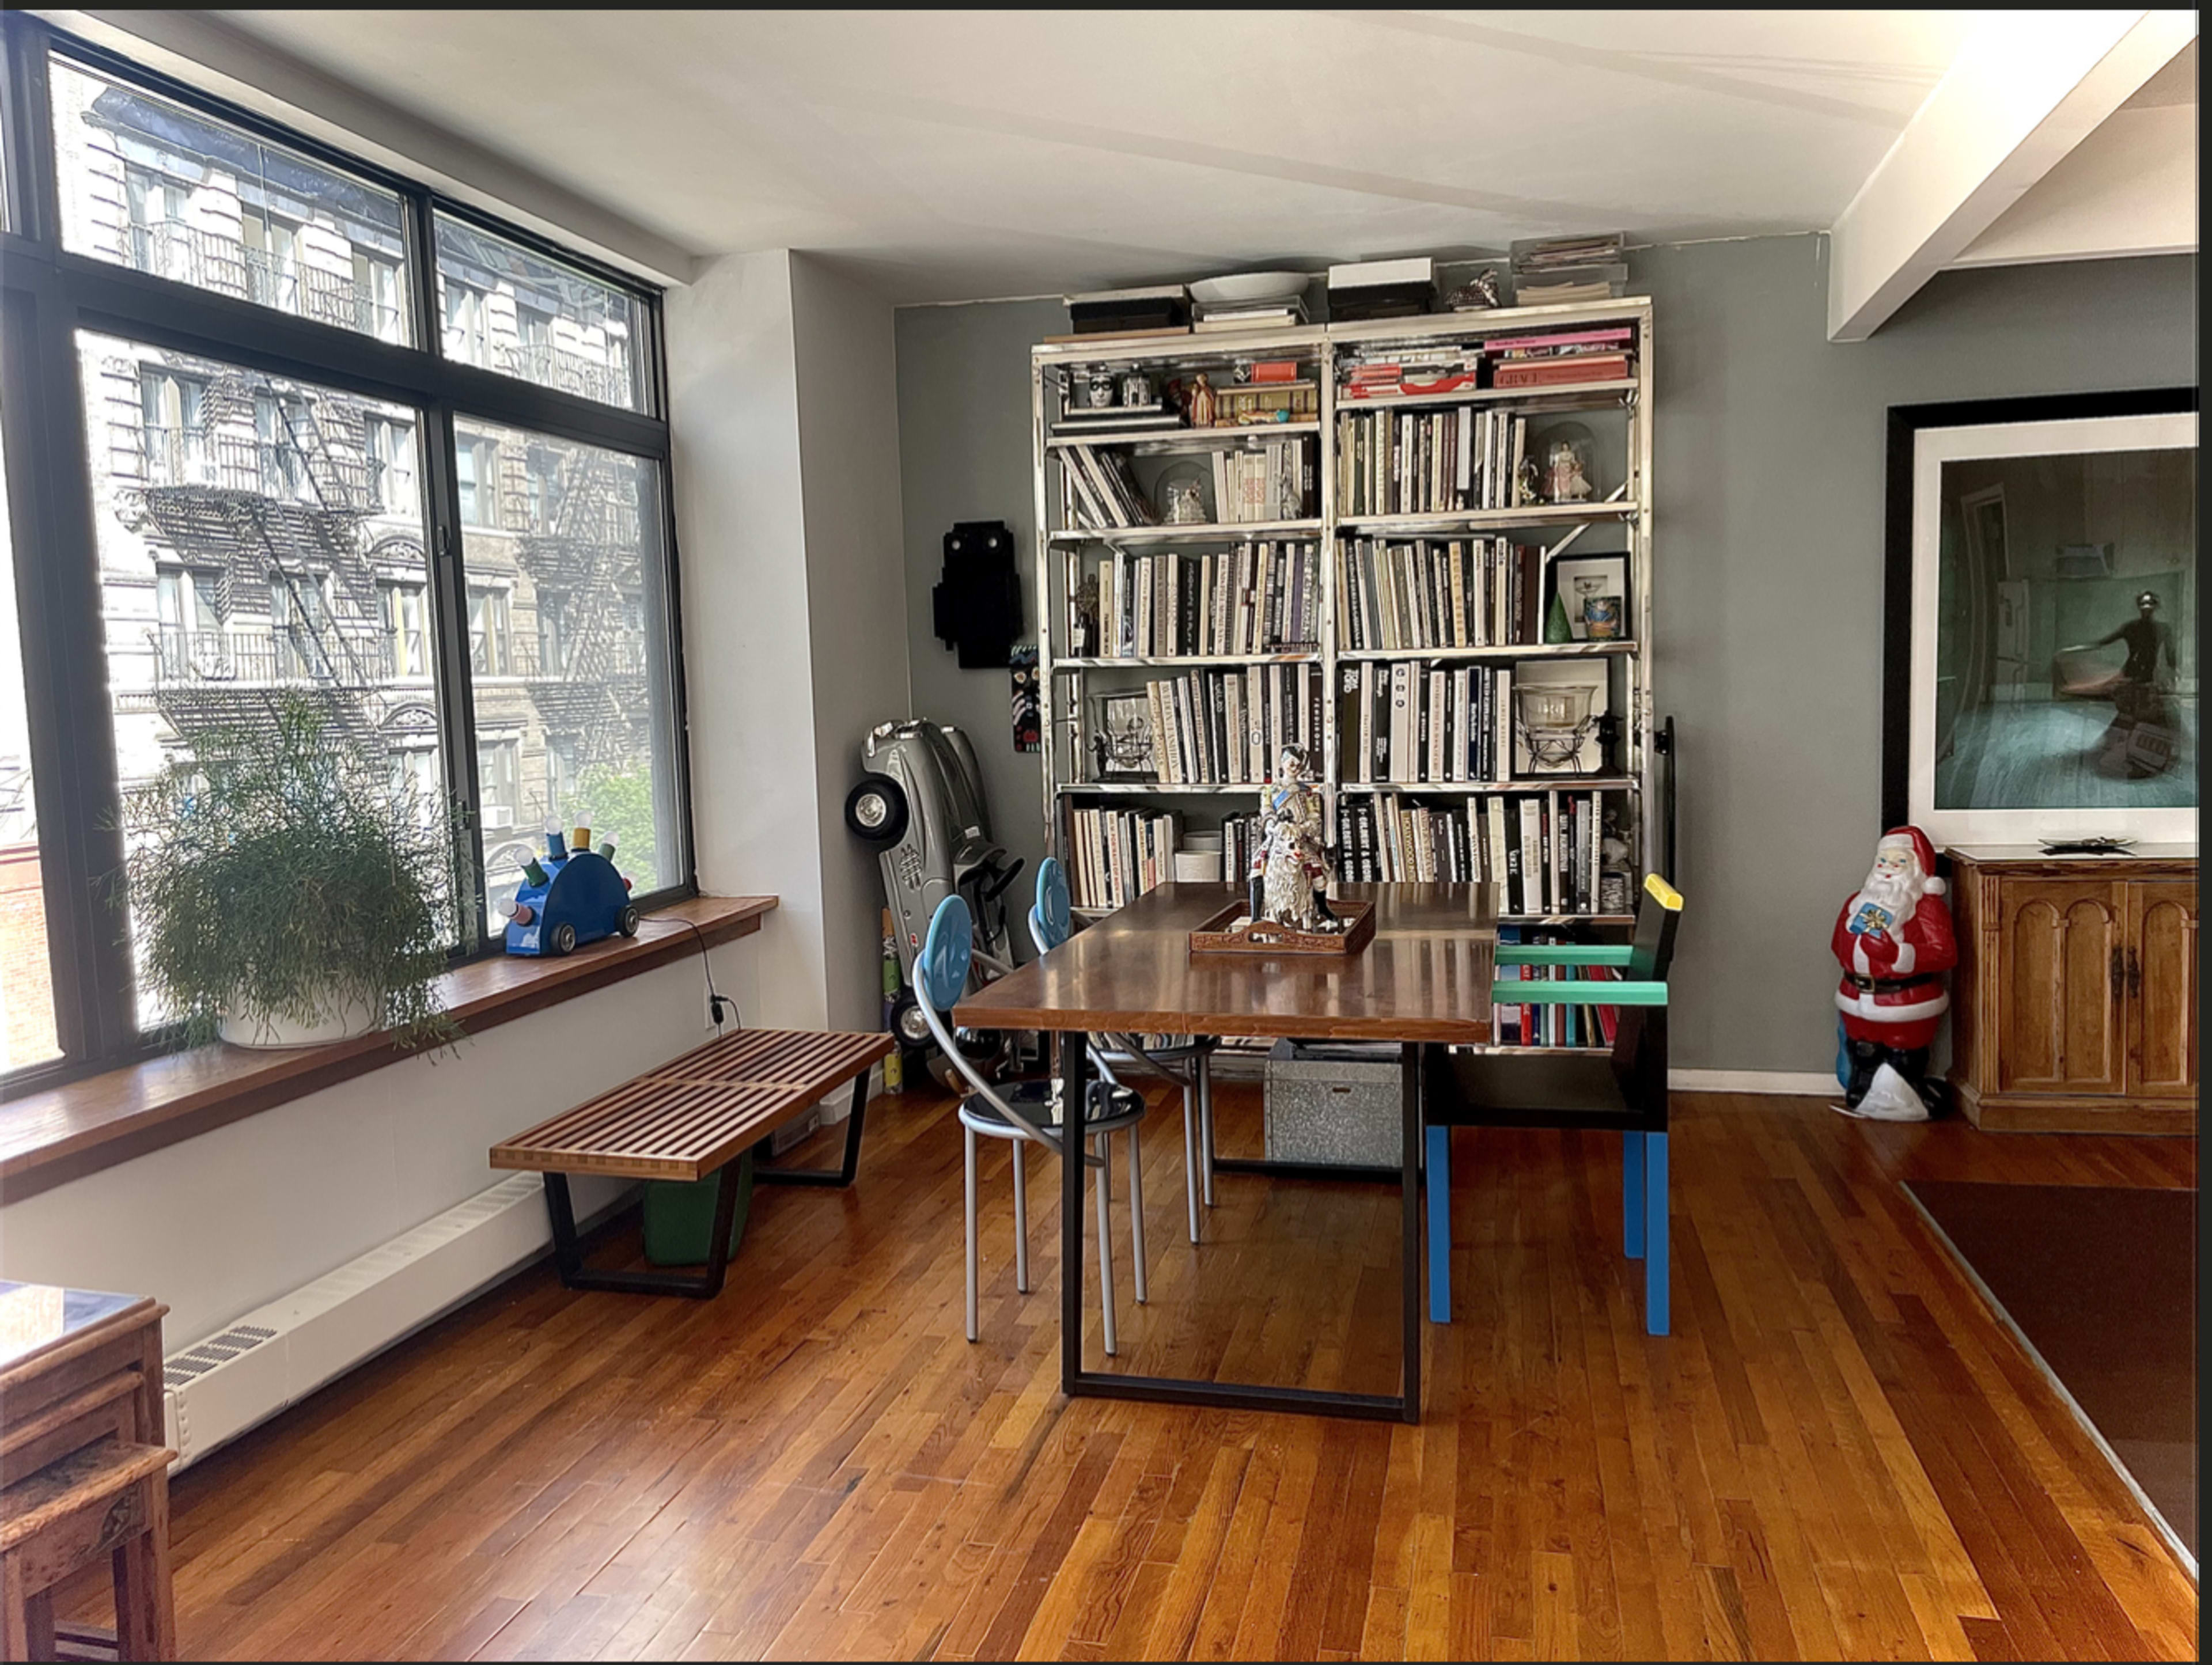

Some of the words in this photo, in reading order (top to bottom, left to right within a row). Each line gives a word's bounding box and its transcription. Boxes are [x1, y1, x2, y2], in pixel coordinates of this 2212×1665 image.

[1498, 541, 1506, 566] male
[1343, 669, 1351, 693] FORD
[1351, 669, 1359, 689] TOM
[1403, 817, 1415, 864] HOLLYWOOD
